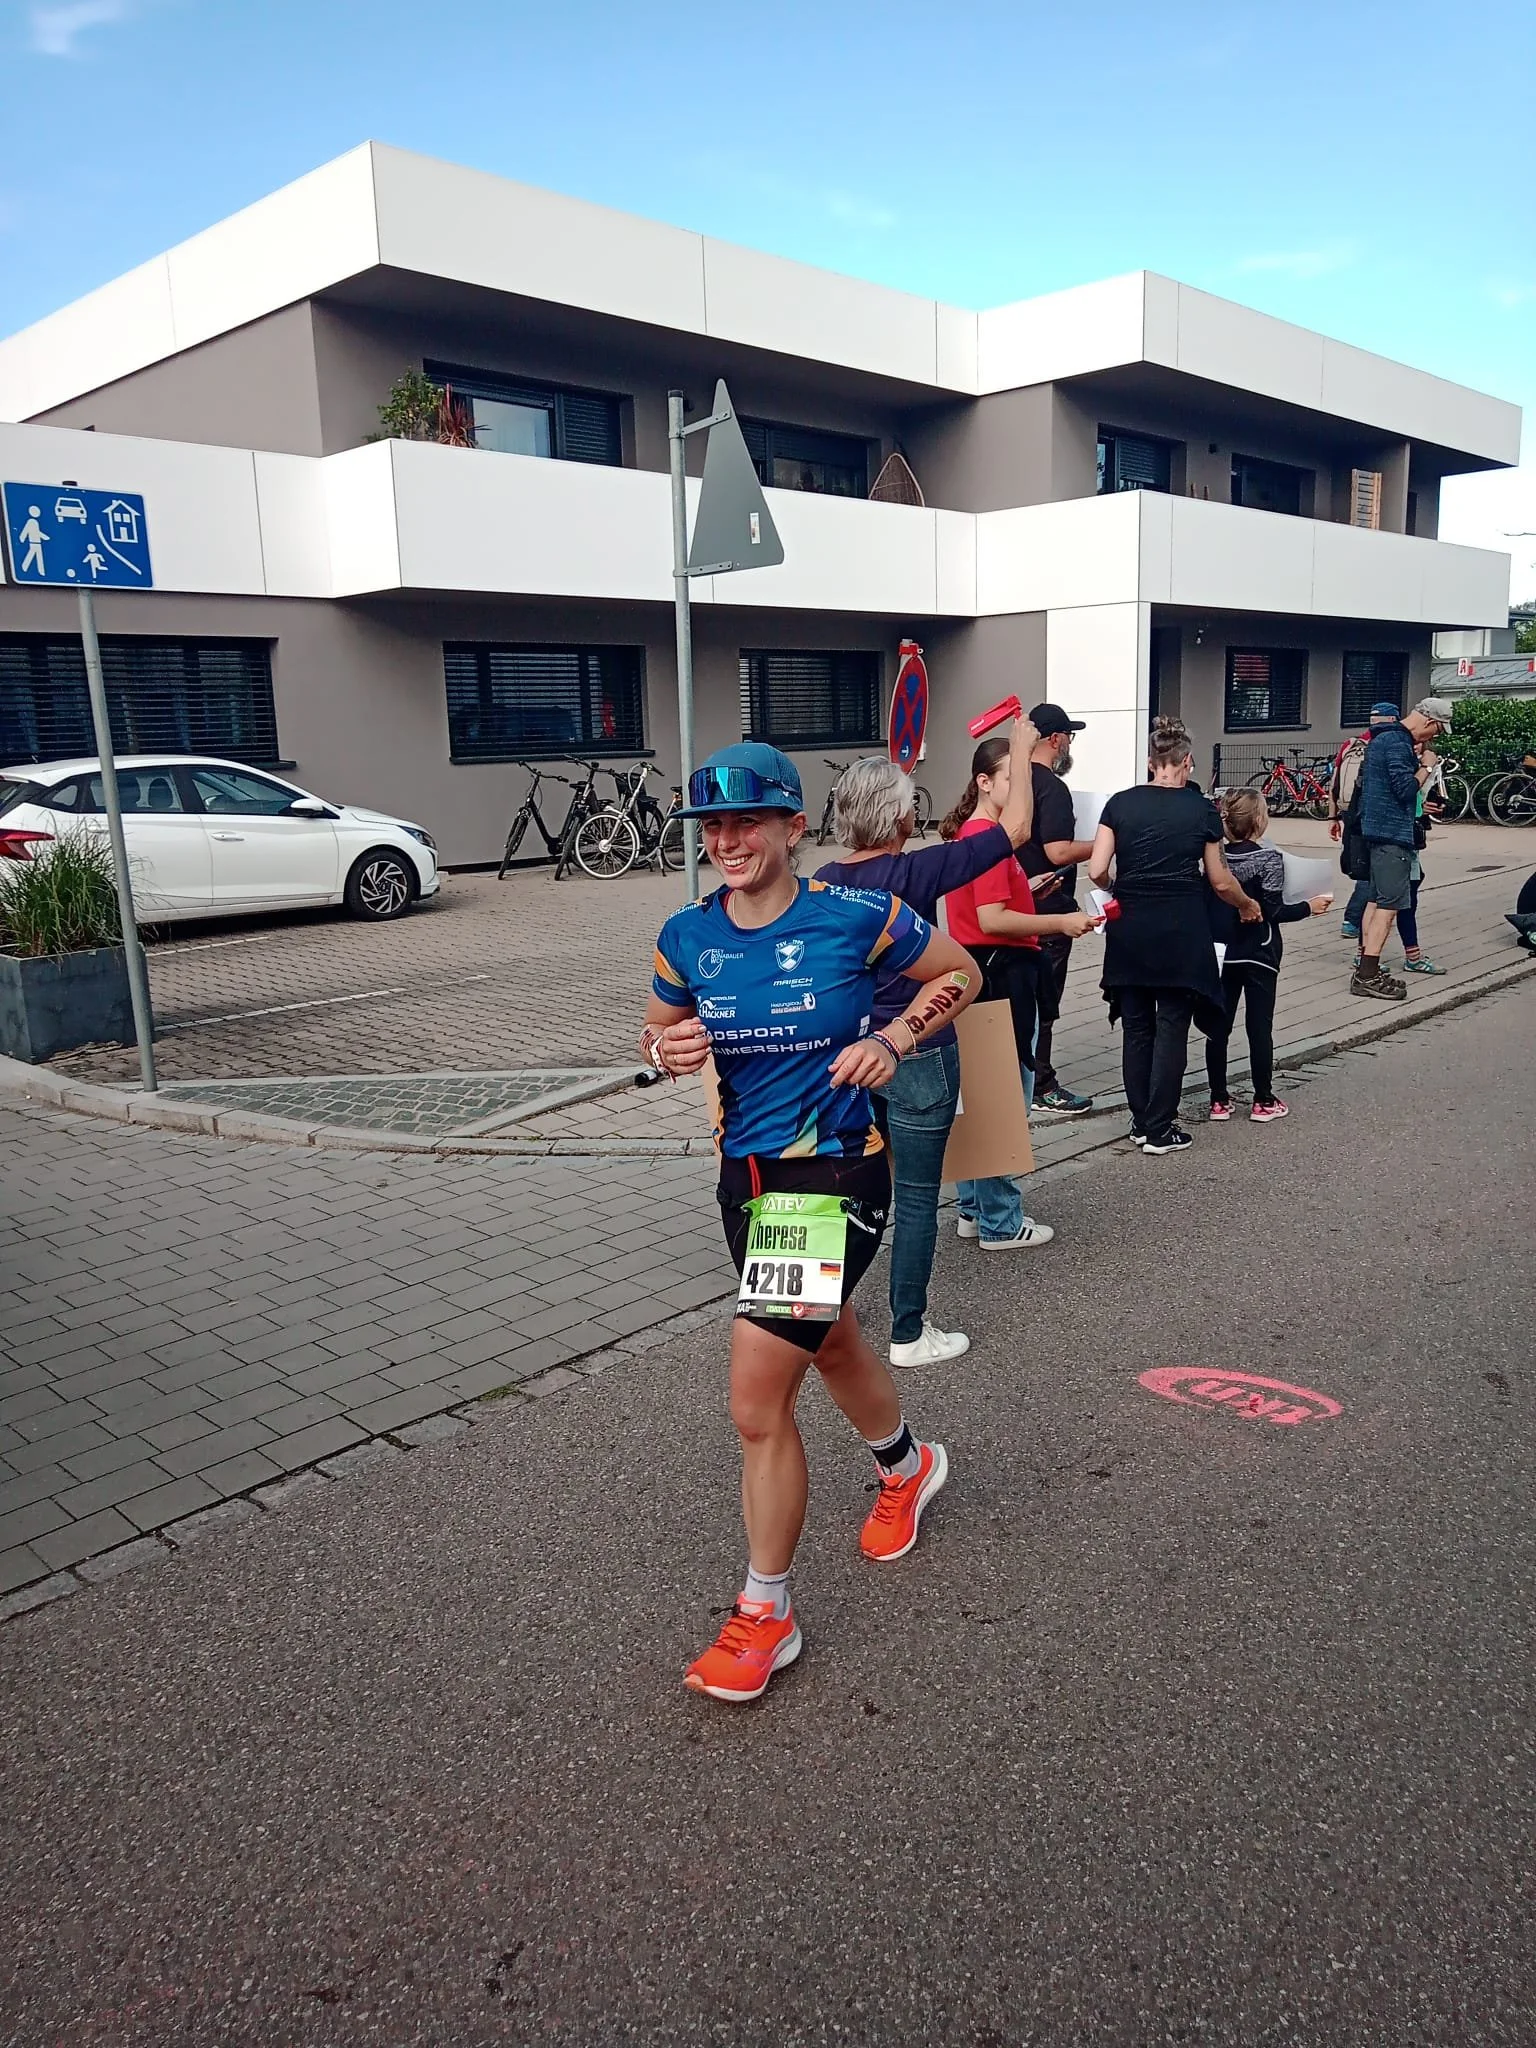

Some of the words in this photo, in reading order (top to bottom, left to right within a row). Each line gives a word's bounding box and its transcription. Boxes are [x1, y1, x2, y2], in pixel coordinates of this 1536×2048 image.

[773, 977, 814, 987] MAISCH
[711, 1037, 831, 1056] AIMERSHEIM
[746, 1262, 803, 1296] 4218
